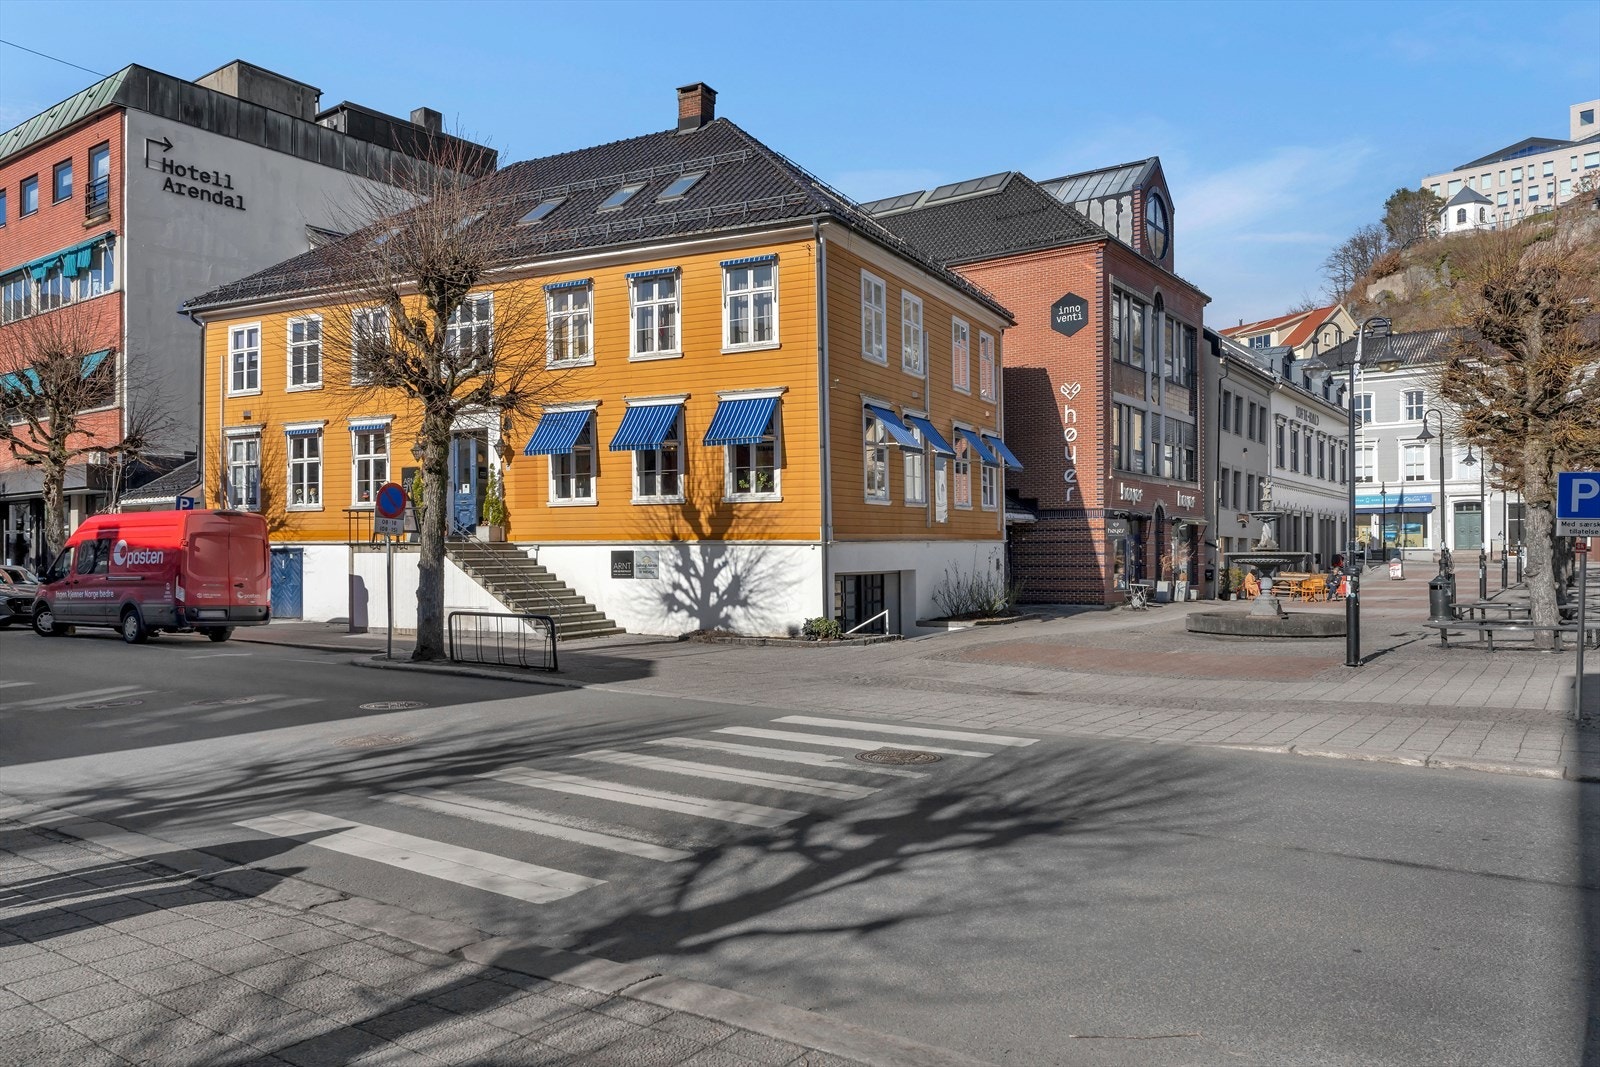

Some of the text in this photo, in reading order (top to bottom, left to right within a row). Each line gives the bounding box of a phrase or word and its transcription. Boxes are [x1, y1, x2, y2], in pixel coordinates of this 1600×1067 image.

[162, 157, 235, 191] Hotell
[162, 176, 247, 212] Arendal
[1056, 312, 1083, 323] venti
[1058, 305, 1081, 315] inno
[1064, 404, 1077, 502] høyer
[180, 498, 190, 510] P
[1571, 478, 1600, 513] P
[127, 548, 163, 568] posten
[84, 589, 98, 599] Norge
[99, 588, 113, 597] bedre
